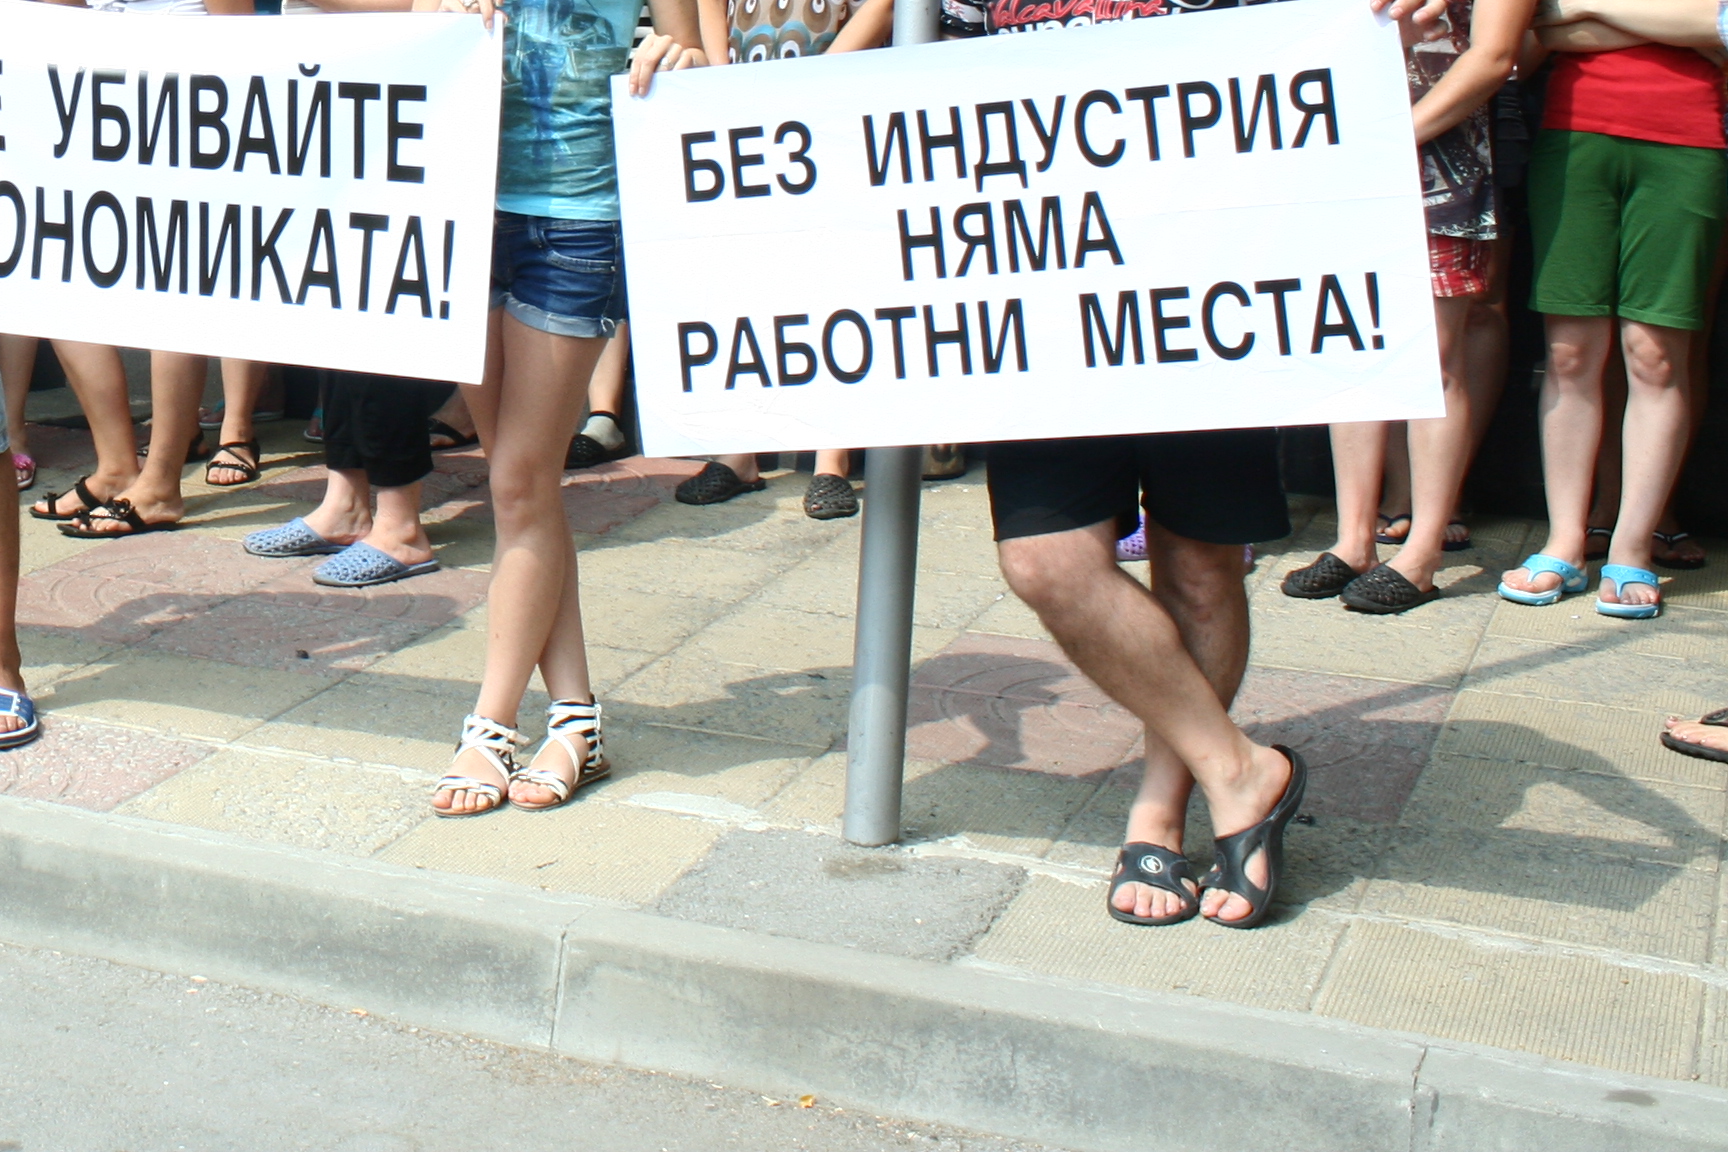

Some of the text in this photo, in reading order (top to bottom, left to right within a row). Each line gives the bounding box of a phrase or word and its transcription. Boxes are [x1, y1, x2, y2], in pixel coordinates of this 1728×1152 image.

[47, 63, 429, 184] УБИВАЙТЕ
[680, 68, 1341, 204] БЕЗ ИНДУСТРИЯ
[897, 190, 1126, 282] НЯМА
[677, 270, 1387, 394] РАБОТНИ МЕСТА!
